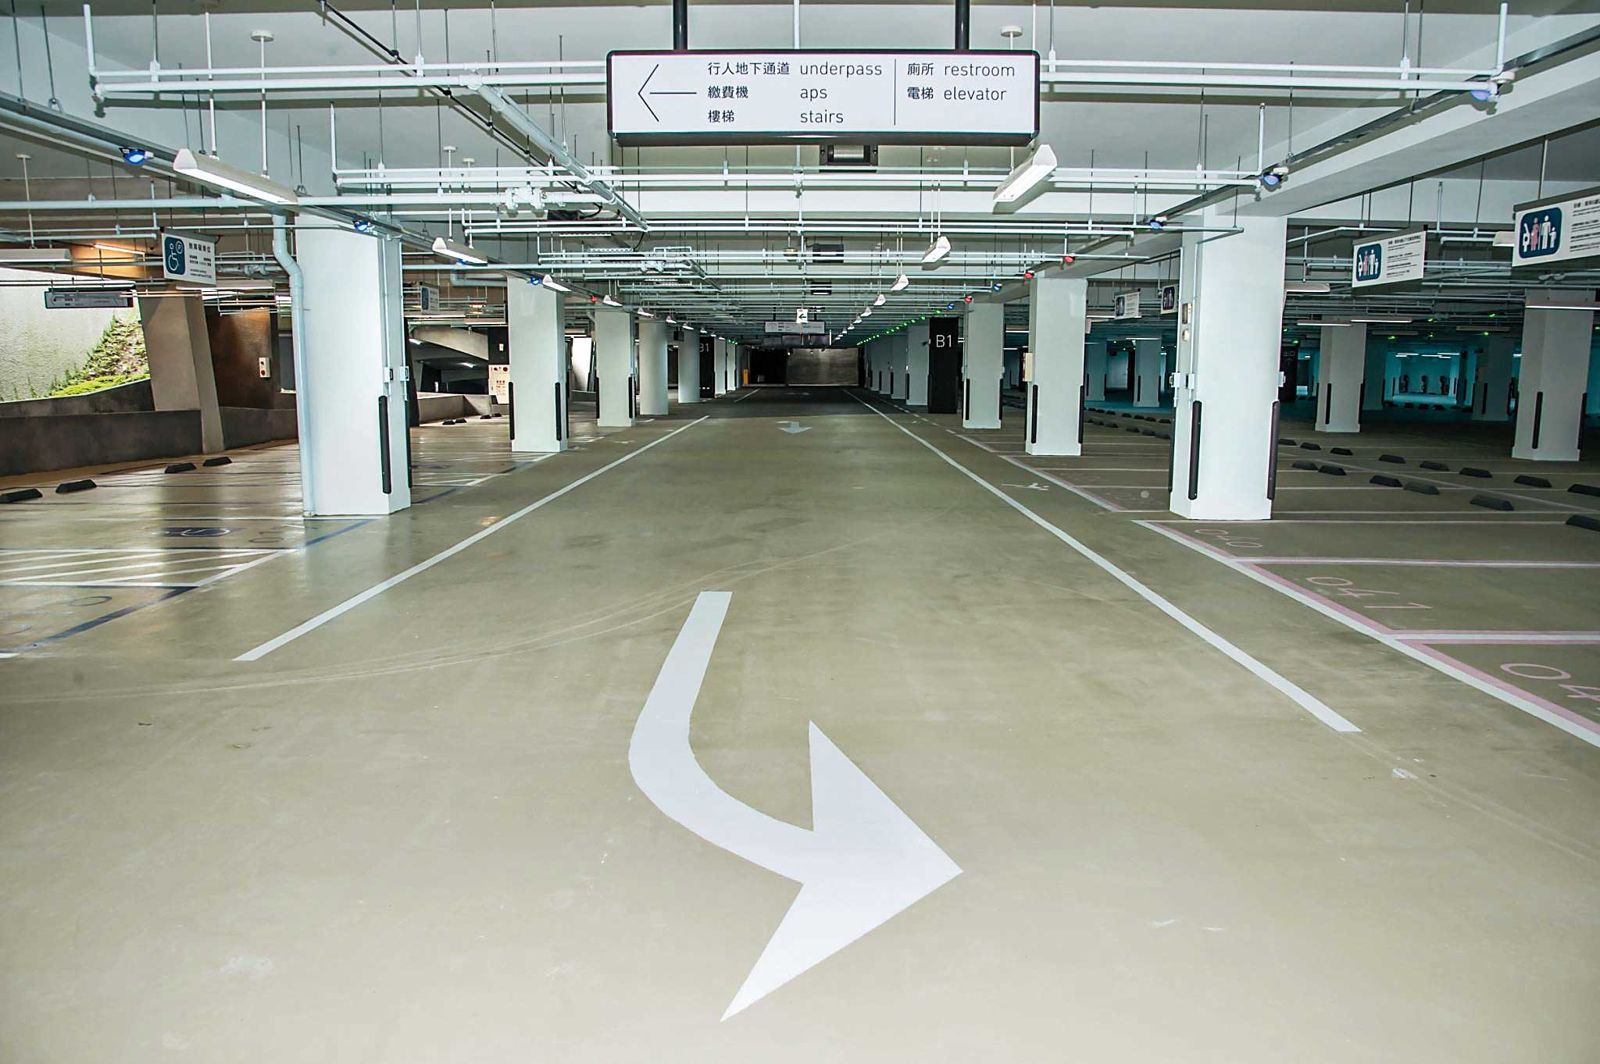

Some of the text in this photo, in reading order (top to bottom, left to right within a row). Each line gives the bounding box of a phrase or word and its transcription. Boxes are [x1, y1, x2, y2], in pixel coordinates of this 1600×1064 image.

[707, 61, 882, 78] 行人地下通道 underpass
[944, 64, 1015, 77] restroom
[707, 85, 828, 101] 繳費機 aps
[907, 86, 1007, 101] 電梯 elevator
[707, 109, 844, 123] 樓梯 stairs
[936, 334, 952, 348] B1
[1305, 576, 1434, 610] 041
